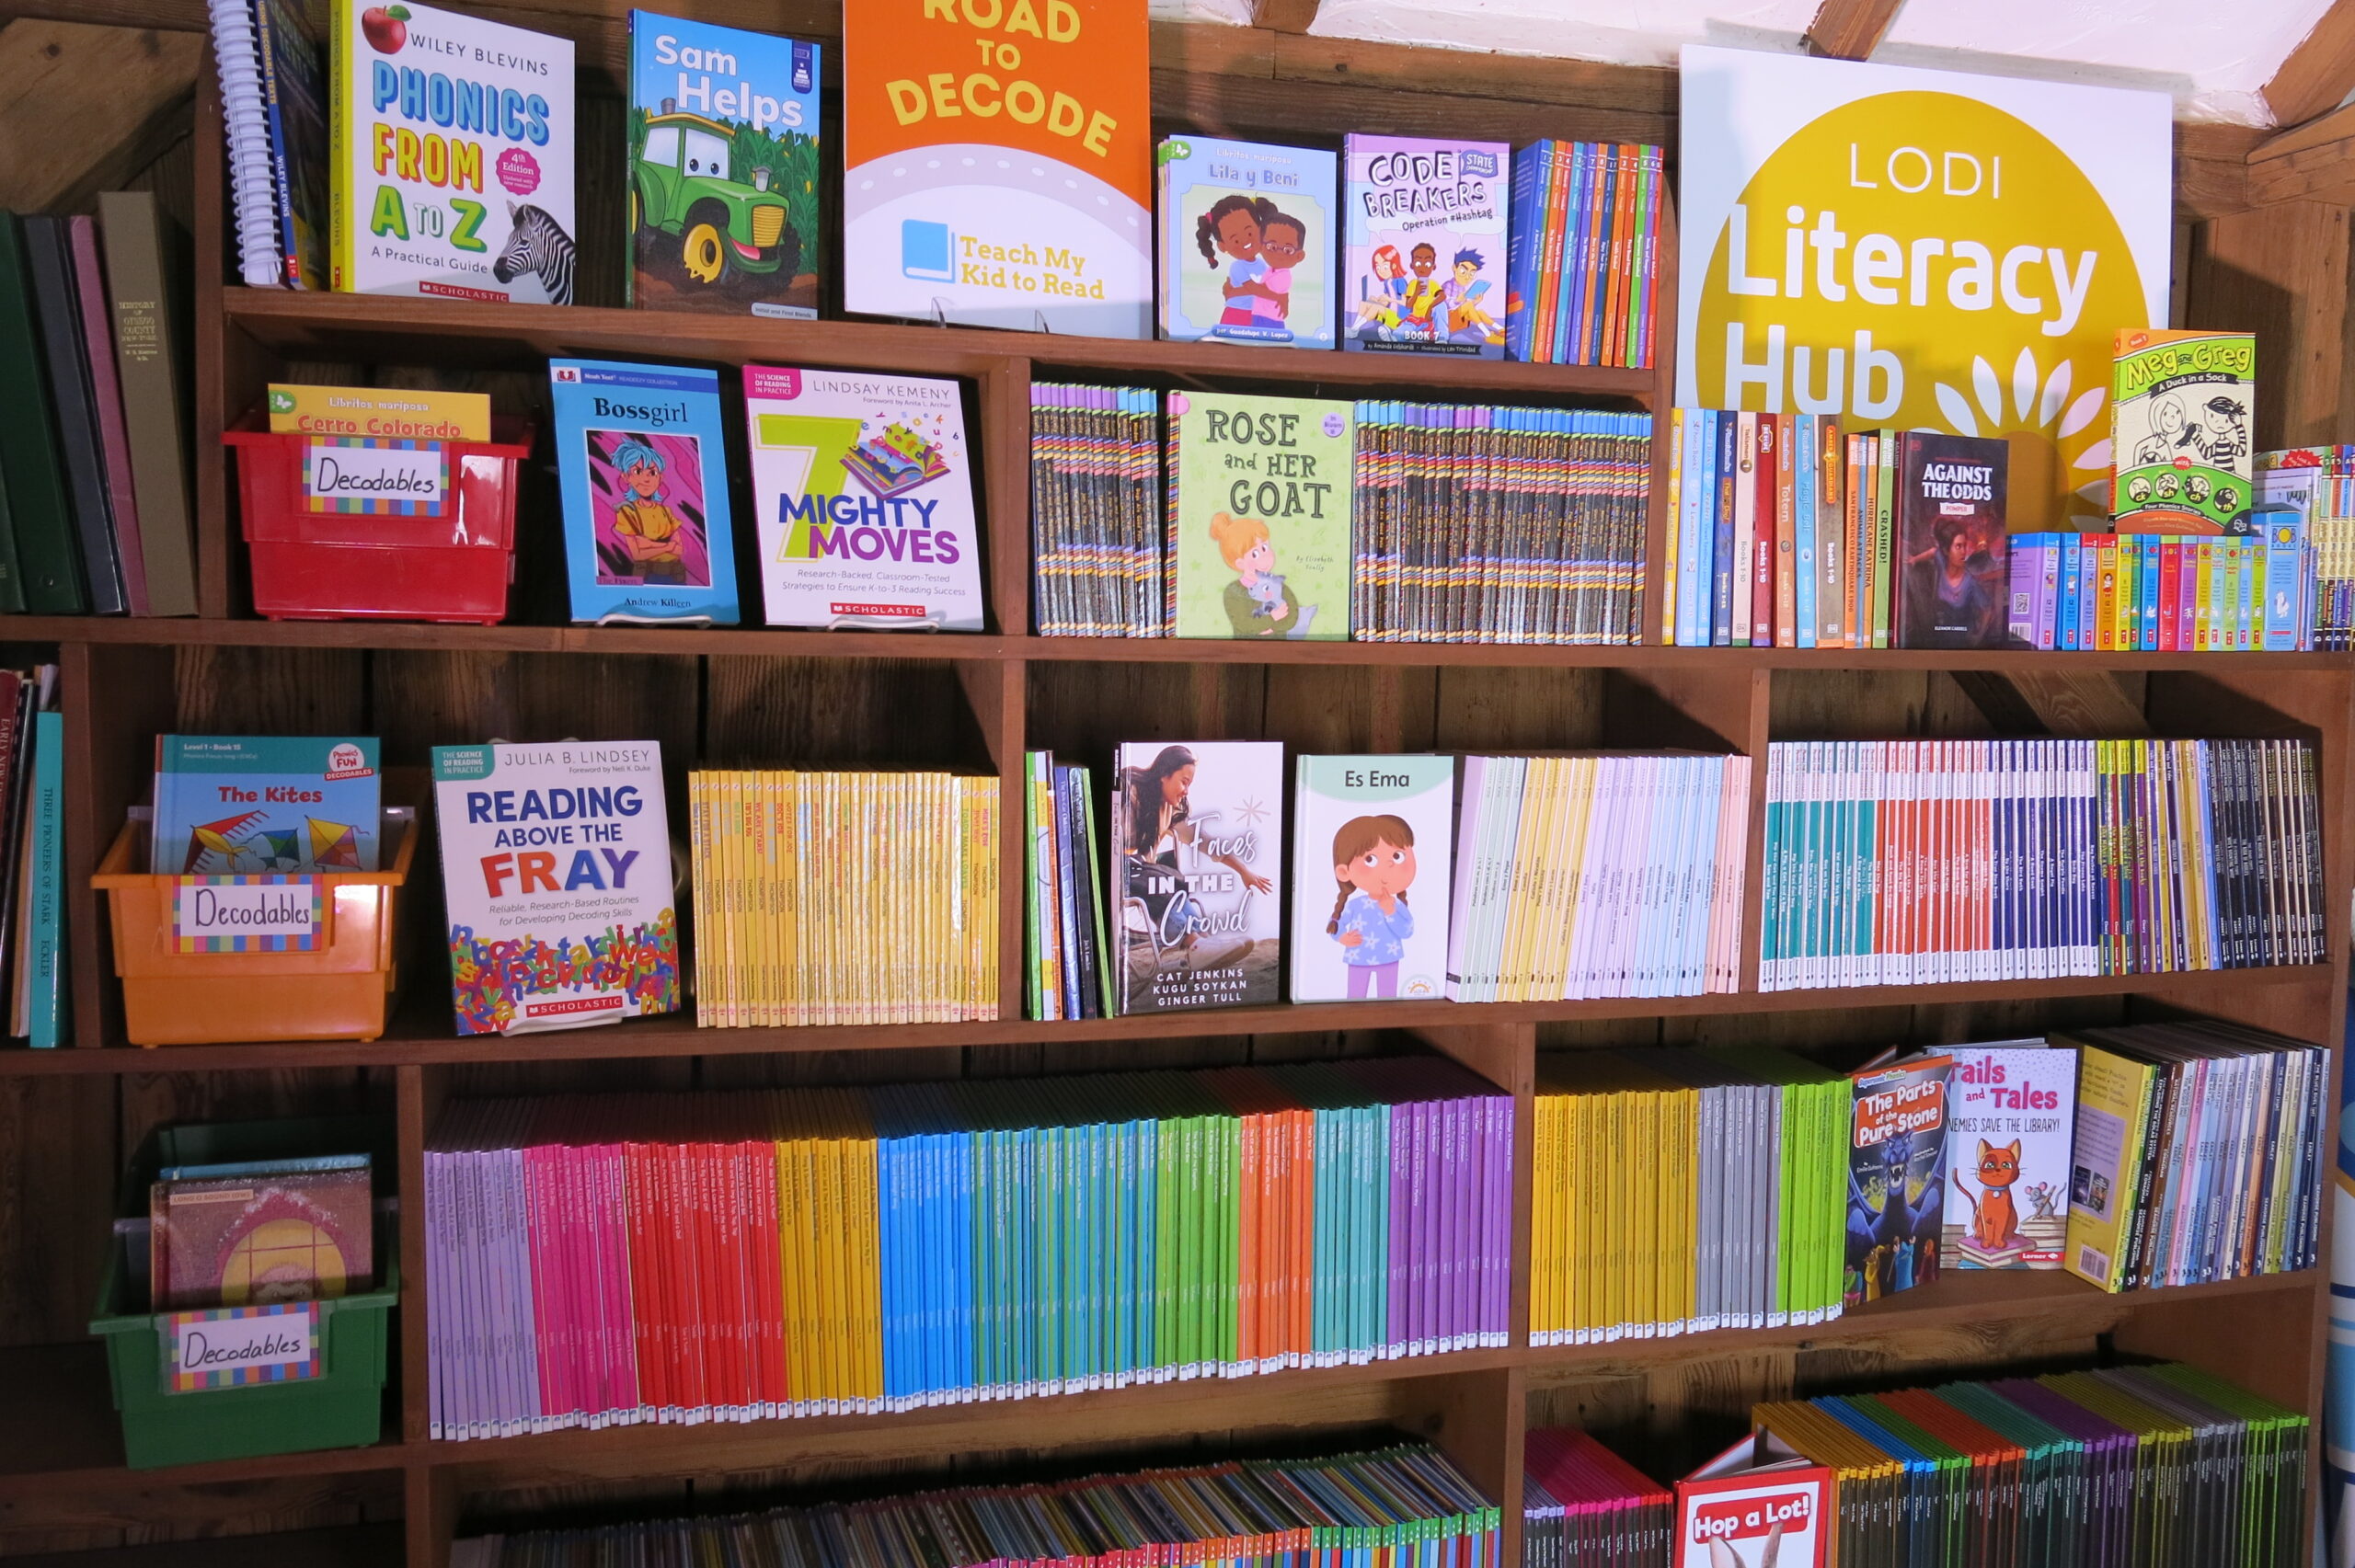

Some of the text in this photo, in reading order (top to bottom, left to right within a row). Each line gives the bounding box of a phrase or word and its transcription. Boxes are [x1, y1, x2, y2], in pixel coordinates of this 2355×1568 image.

[411, 33, 549, 76] WILEY BLEVINS
[655, 34, 737, 76] Sam
[976, 39, 1021, 71] TO
[373, 60, 549, 146] PHONICS
[677, 72, 804, 132] Helps
[886, 73, 1117, 157] DECODE
[373, 122, 484, 194] FROM
[502, 161, 535, 176] Edition
[511, 154, 527, 163] 4th
[1369, 150, 1453, 187] CODE
[1465, 154, 1494, 168] STATE
[1209, 164, 1299, 187] Lila y Beni
[1850, 143, 2001, 200] LODI
[276, 154, 290, 218] WILEY BLEVINS
[1363, 182, 1487, 218] BREAKERS
[371, 185, 488, 254] A TO Z
[1402, 208, 1493, 232] Operation #Hashtag
[372, 246, 488, 274] A Practical Guide
[959, 235, 1086, 276] Teach My
[960, 263, 1105, 300] Kid to Read
[1728, 203, 2097, 338] Literacy
[432, 284, 507, 303] SCHOLASTIC
[1404, 330, 1430, 341] BOOK
[754, 372, 791, 382] THE SCIENCE
[1724, 322, 1904, 420] Hub
[2127, 345, 2251, 390] Meg Greg
[764, 380, 791, 388] READING
[813, 380, 949, 400] LINDSAY KEMENY
[2165, 373, 2227, 390] Duck Sock
[328, 396, 430, 413] Libritos mariposa
[593, 397, 688, 428] Bossgirl
[863, 396, 951, 409] Foreword Archer
[297, 415, 462, 438] Cerro Colorado
[1206, 409, 1300, 447] ROSE
[316, 456, 435, 493] Decodables
[1224, 452, 1316, 478] and HER
[1923, 464, 1993, 485] AGAINST
[1230, 479, 1332, 519] GOAT
[1781, 484, 1791, 522] Totem
[1922, 481, 1993, 501] THE ODDS
[2135, 492, 2146, 501] ck
[2164, 488, 2174, 498] sh
[2190, 492, 2201, 501] ch
[779, 493, 938, 529] MIGHTY
[2223, 502, 2233, 511] th
[809, 525, 960, 565] MOVES
[1878, 509, 1889, 564] CRASHED!
[1759, 542, 1768, 583] Books 1-10
[1827, 542, 1835, 584] Books 1-10
[1865, 547, 1873, 589] KATRINA
[782, 581, 967, 596] Strategies Ensure K-to-3 Reading Success
[876, 571, 950, 583] Classroom-Tested
[625, 597, 691, 608] Andrew Killeen
[844, 605, 925, 616] SCHOLASTIC
[1, 718, 11, 750] EARLY
[333, 749, 359, 760] Phonics
[337, 756, 358, 769] FUN
[456, 750, 483, 759] SCIENCE
[504, 750, 650, 766] JULIA B. LINDSEY
[326, 768, 373, 780] DECODABLES
[453, 765, 484, 773] PRACTICE
[1345, 770, 1410, 787] Es Ema
[218, 786, 324, 804] The Kites
[466, 785, 643, 824] READING
[494, 823, 623, 848] ABOVE THE
[40, 788, 53, 978] THREE PIONEERS STARK ECKLER
[480, 847, 640, 898] FRAY
[1147, 875, 1234, 895] IN THE
[195, 888, 310, 927] Decodables
[489, 896, 639, 915] Reliable, Research-Based Routines
[499, 908, 633, 927] for Developing Decoding Skills
[1159, 887, 1254, 947] Crowd
[1153, 980, 1247, 995] KUGU SOYKAN
[1156, 968, 1245, 982] CAT JENKINS
[540, 998, 622, 1013] SCHOLASTIC
[1158, 991, 1242, 1006] GINGER TULL
[1950, 1055, 2005, 1084] Tails
[1866, 1080, 1936, 1116] The Parts
[1966, 1081, 2058, 1110] and Tales
[1859, 1106, 1938, 1146] Pure Stone
[1885, 1111, 1897, 1122] the
[1981, 1117, 2003, 1132] SAVE
[2006, 1117, 2021, 1132] THE
[2024, 1117, 2061, 1133] LIBRARY!
[2022, 1253, 2047, 1261] Lerner
[185, 1333, 301, 1368] Decodables
[1694, 1495, 1810, 1539] Hop a Lot!
